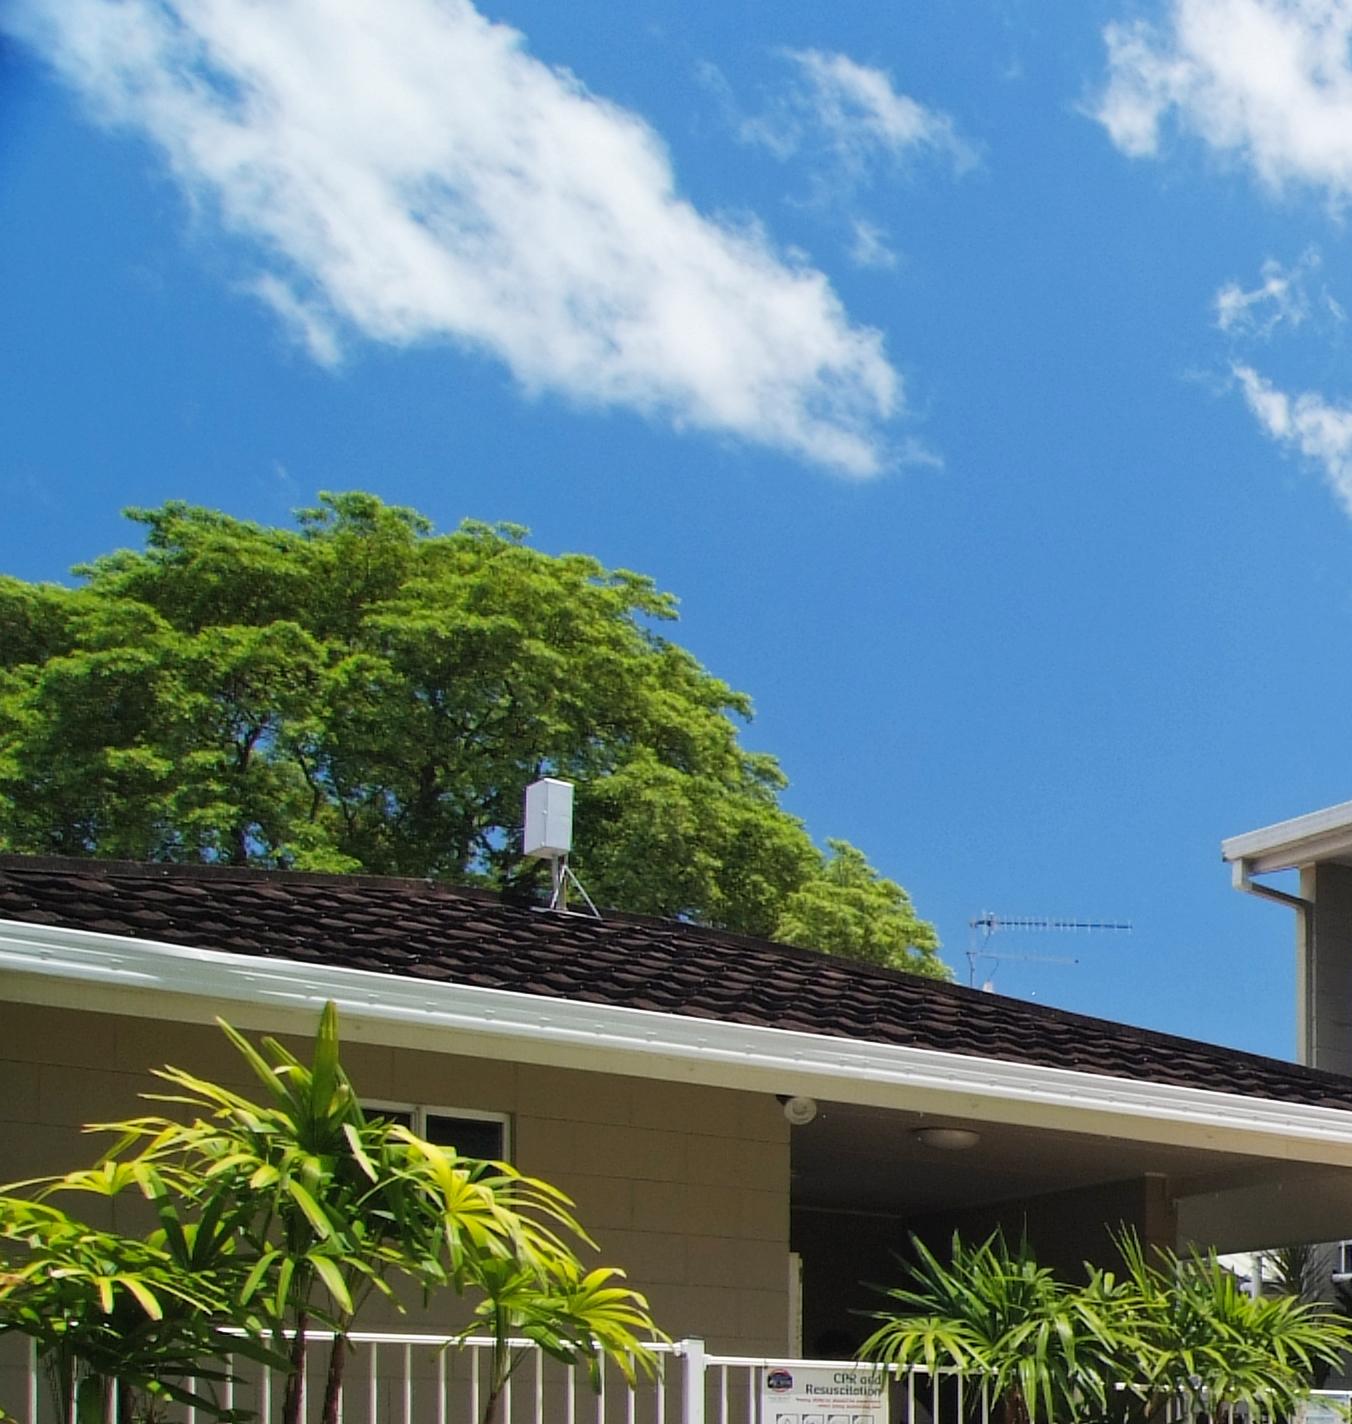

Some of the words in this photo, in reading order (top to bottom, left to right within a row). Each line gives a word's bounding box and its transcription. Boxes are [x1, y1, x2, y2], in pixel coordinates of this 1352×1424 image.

[833, 1372, 857, 1385] CPR
[860, 1373, 882, 1385] and
[805, 1384, 882, 1397] Resuscitation
